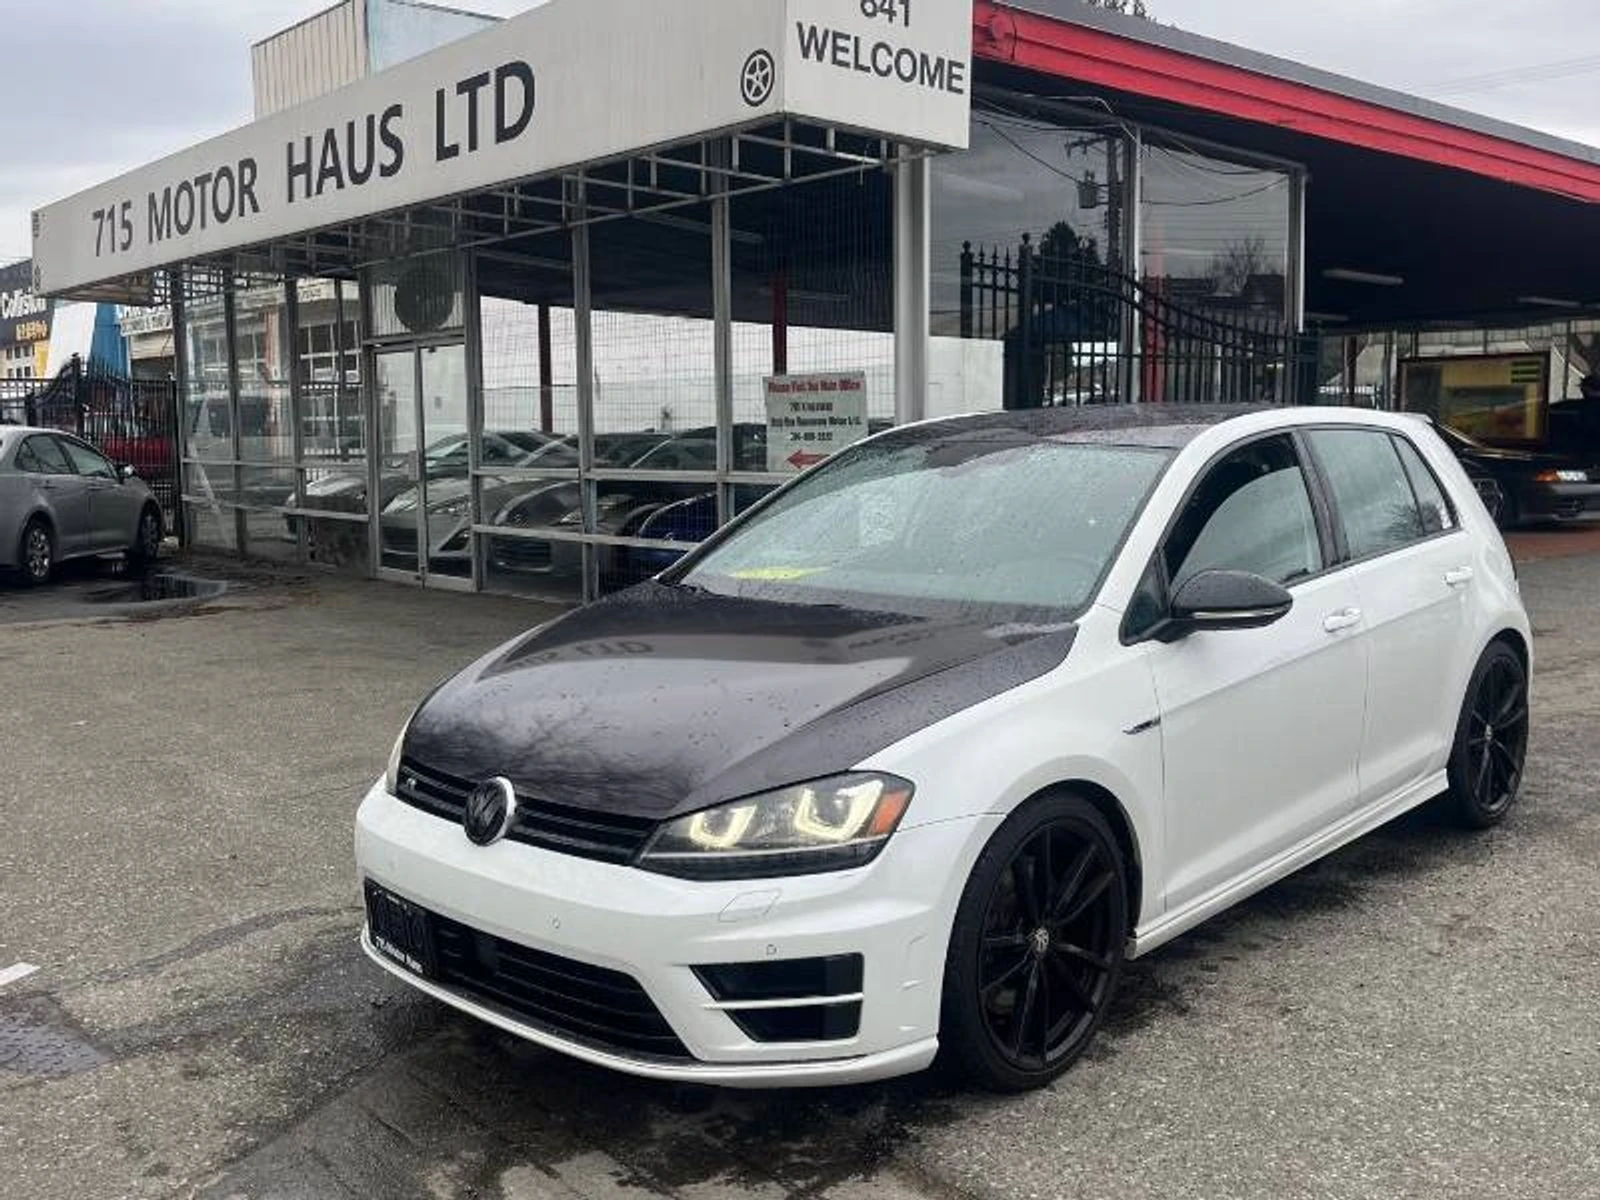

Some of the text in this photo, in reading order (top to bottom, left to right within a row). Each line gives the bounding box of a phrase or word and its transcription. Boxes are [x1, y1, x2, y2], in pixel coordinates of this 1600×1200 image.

[796, 21, 965, 95] WELCOME
[92, 60, 535, 257] 715 MOTOR HAUS LTD
